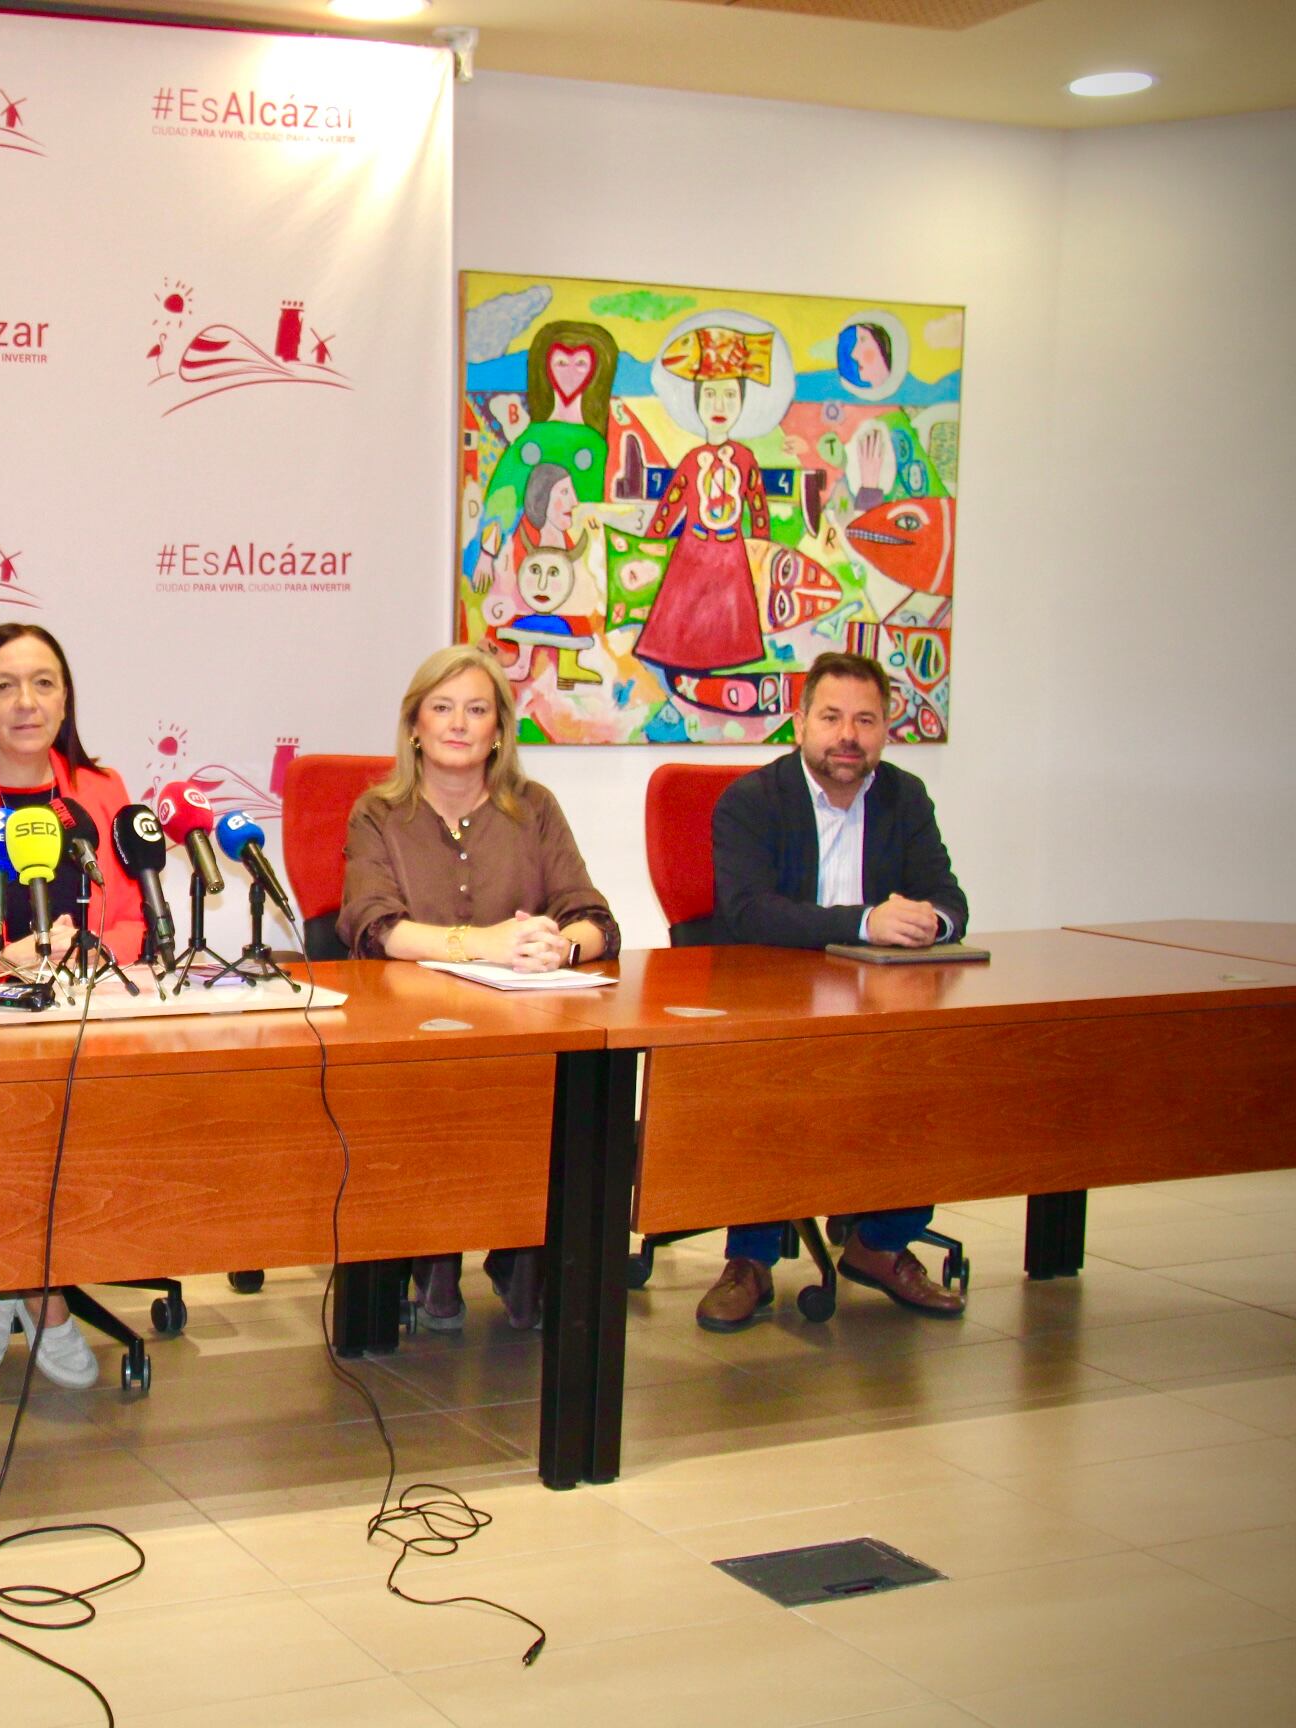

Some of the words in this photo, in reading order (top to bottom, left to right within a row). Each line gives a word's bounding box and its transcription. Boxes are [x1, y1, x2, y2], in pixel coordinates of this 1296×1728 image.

[152, 126, 188, 136] CIUDAD
[191, 128, 215, 138] PARA
[218, 130, 246, 141] VIVIR,
[2, 353, 47, 364] INVERTIR
[825, 438, 836, 456] T
[826, 527, 837, 549] R
[156, 543, 352, 576] #EsAlcázar
[155, 583, 191, 593] CIUDAD
[193, 583, 216, 592] PARA
[220, 583, 245, 593] VIVIR,
[248, 583, 281, 593] CIUDAD
[284, 583, 307, 592] PARA
[310, 583, 351, 592] INVERTIR
[15, 821, 58, 838] SER
